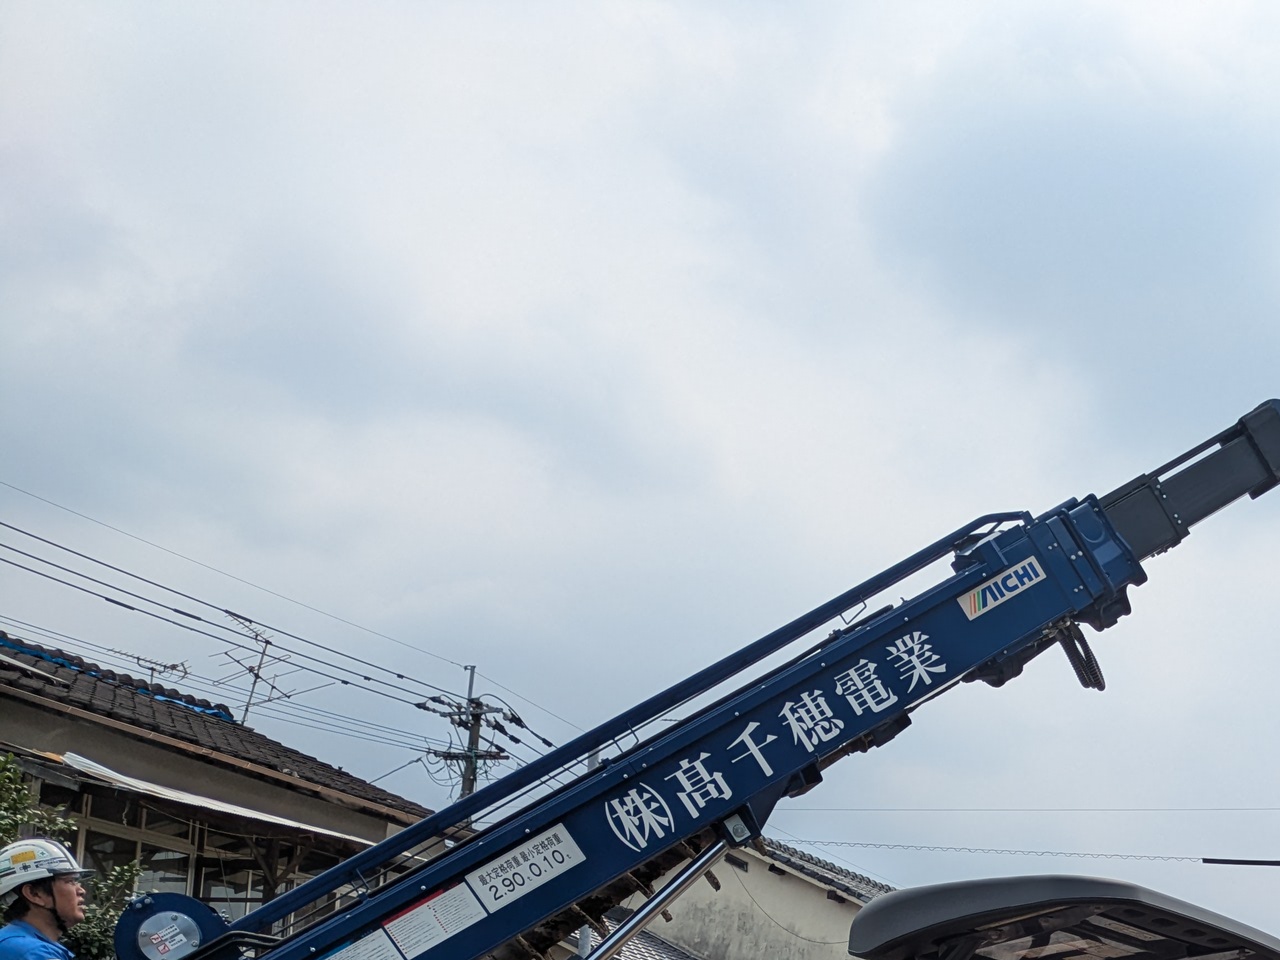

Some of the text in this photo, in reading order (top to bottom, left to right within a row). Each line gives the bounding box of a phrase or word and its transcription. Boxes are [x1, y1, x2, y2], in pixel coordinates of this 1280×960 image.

[980, 557, 1041, 609] AICHI
[478, 833, 563, 886] 最大定格荷重 最小定格荷重
